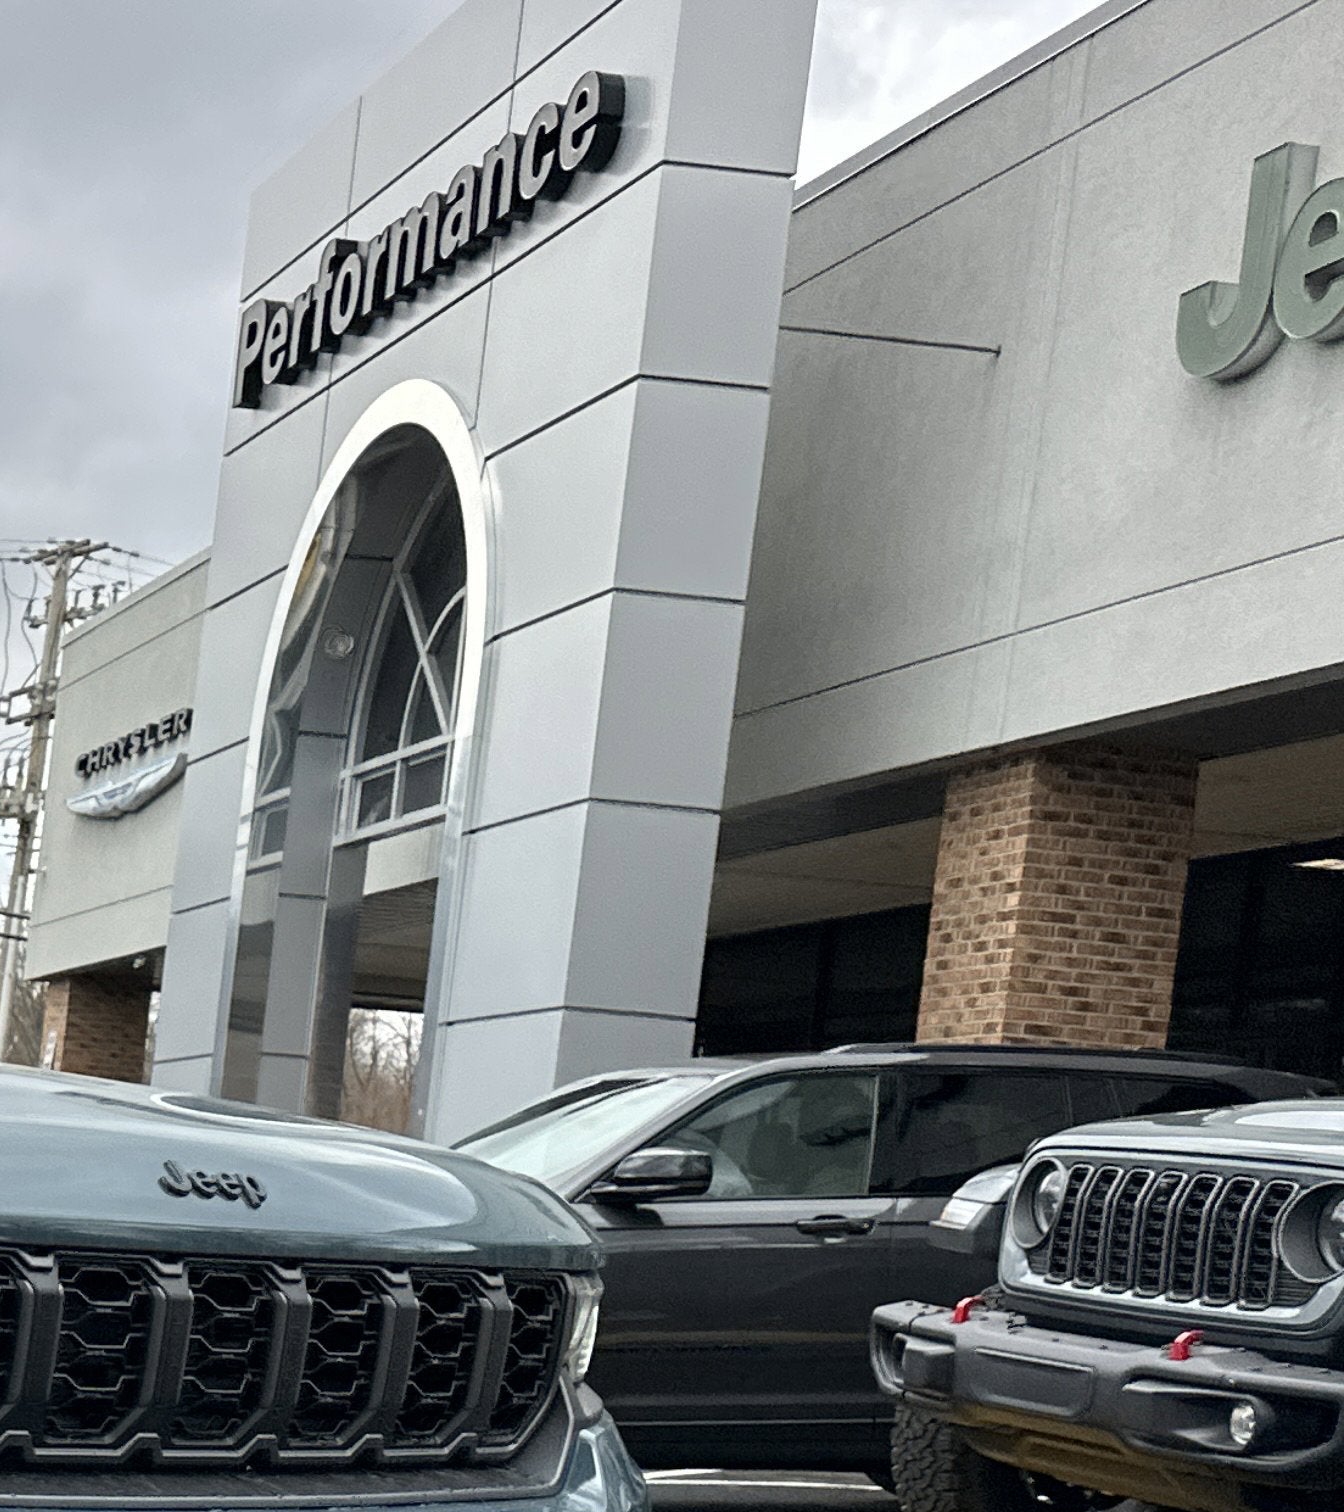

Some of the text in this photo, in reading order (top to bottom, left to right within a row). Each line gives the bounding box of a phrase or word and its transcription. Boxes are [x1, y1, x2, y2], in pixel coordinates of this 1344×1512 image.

[232, 70, 624, 408] Performance
[76, 708, 193, 777] CHRYSLER
[157, 1159, 267, 1210] Jeep
